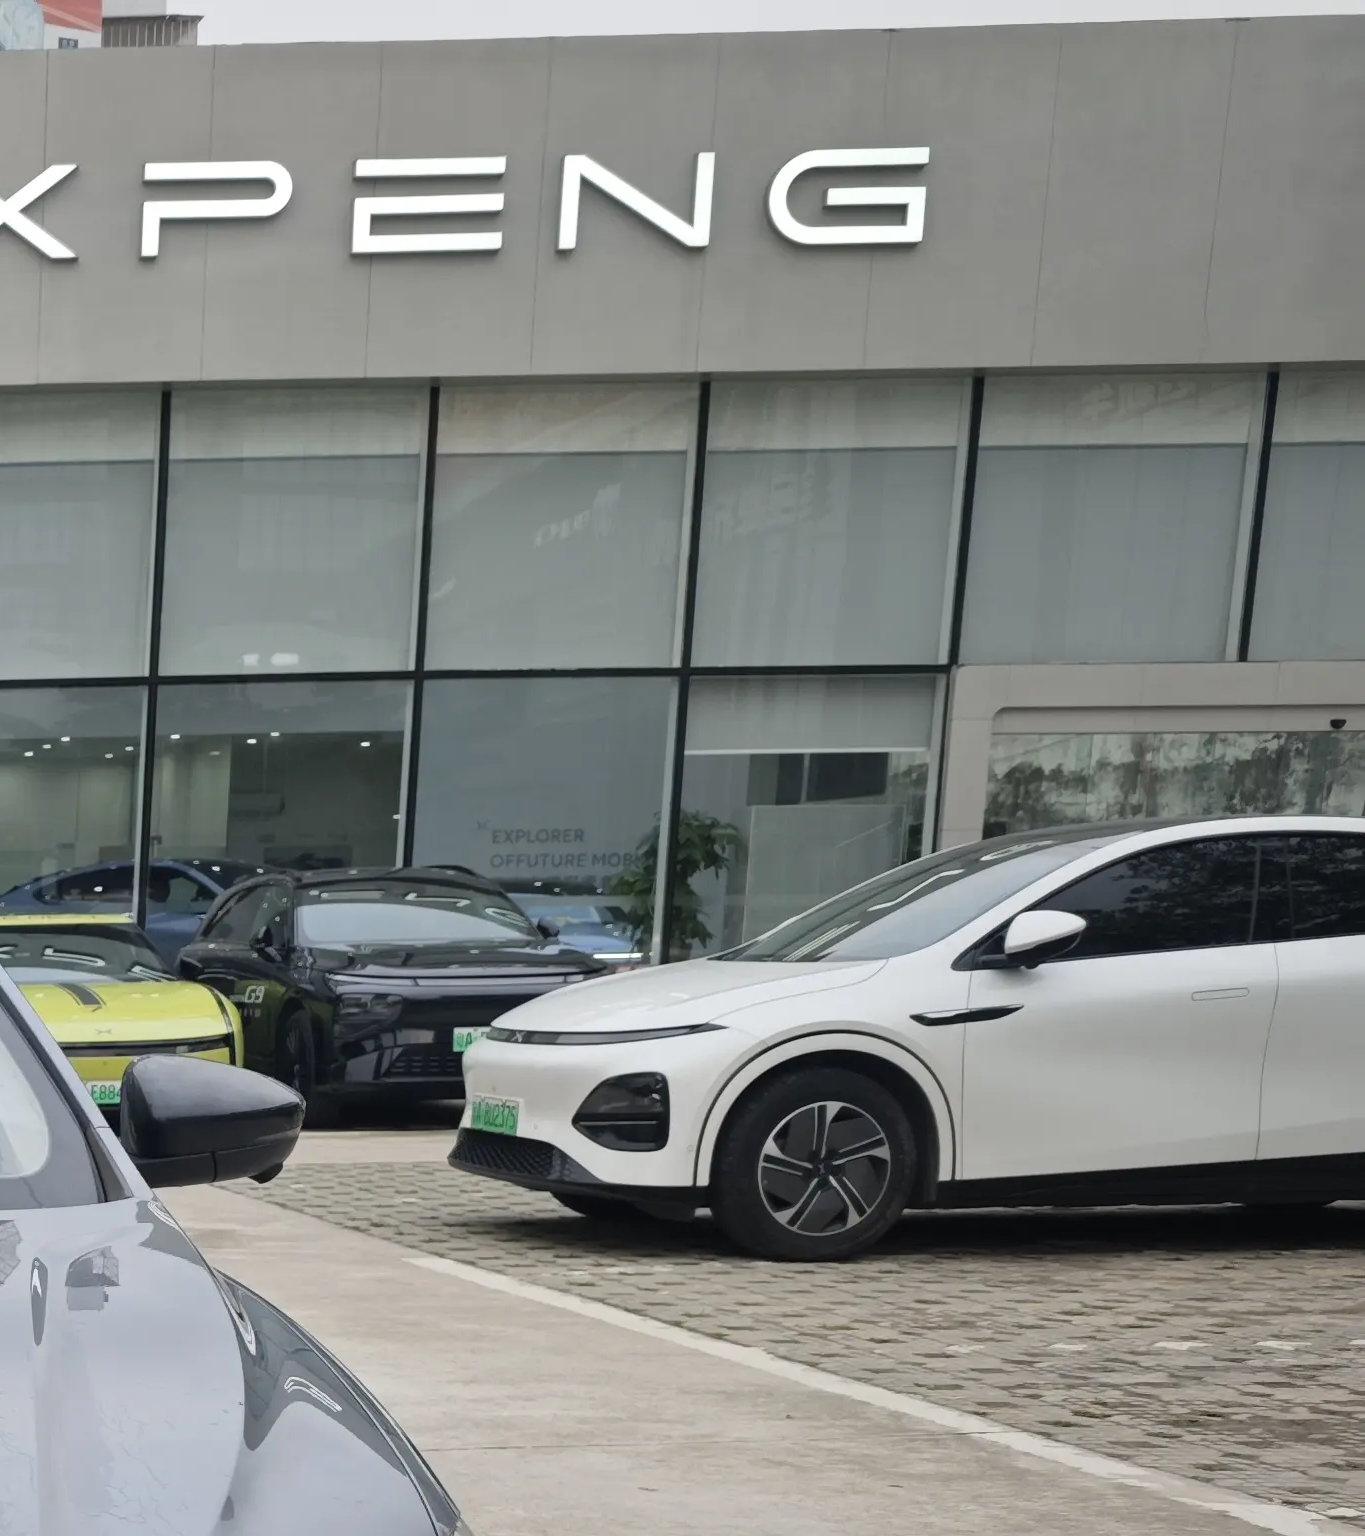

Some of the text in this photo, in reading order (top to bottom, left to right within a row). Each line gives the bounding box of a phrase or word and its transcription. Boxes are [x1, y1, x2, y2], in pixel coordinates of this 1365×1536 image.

[491, 828, 585, 845] EXPLORER
[490, 852, 636, 868] OFFUTURE MOB
[244, 985, 266, 1003] G9
